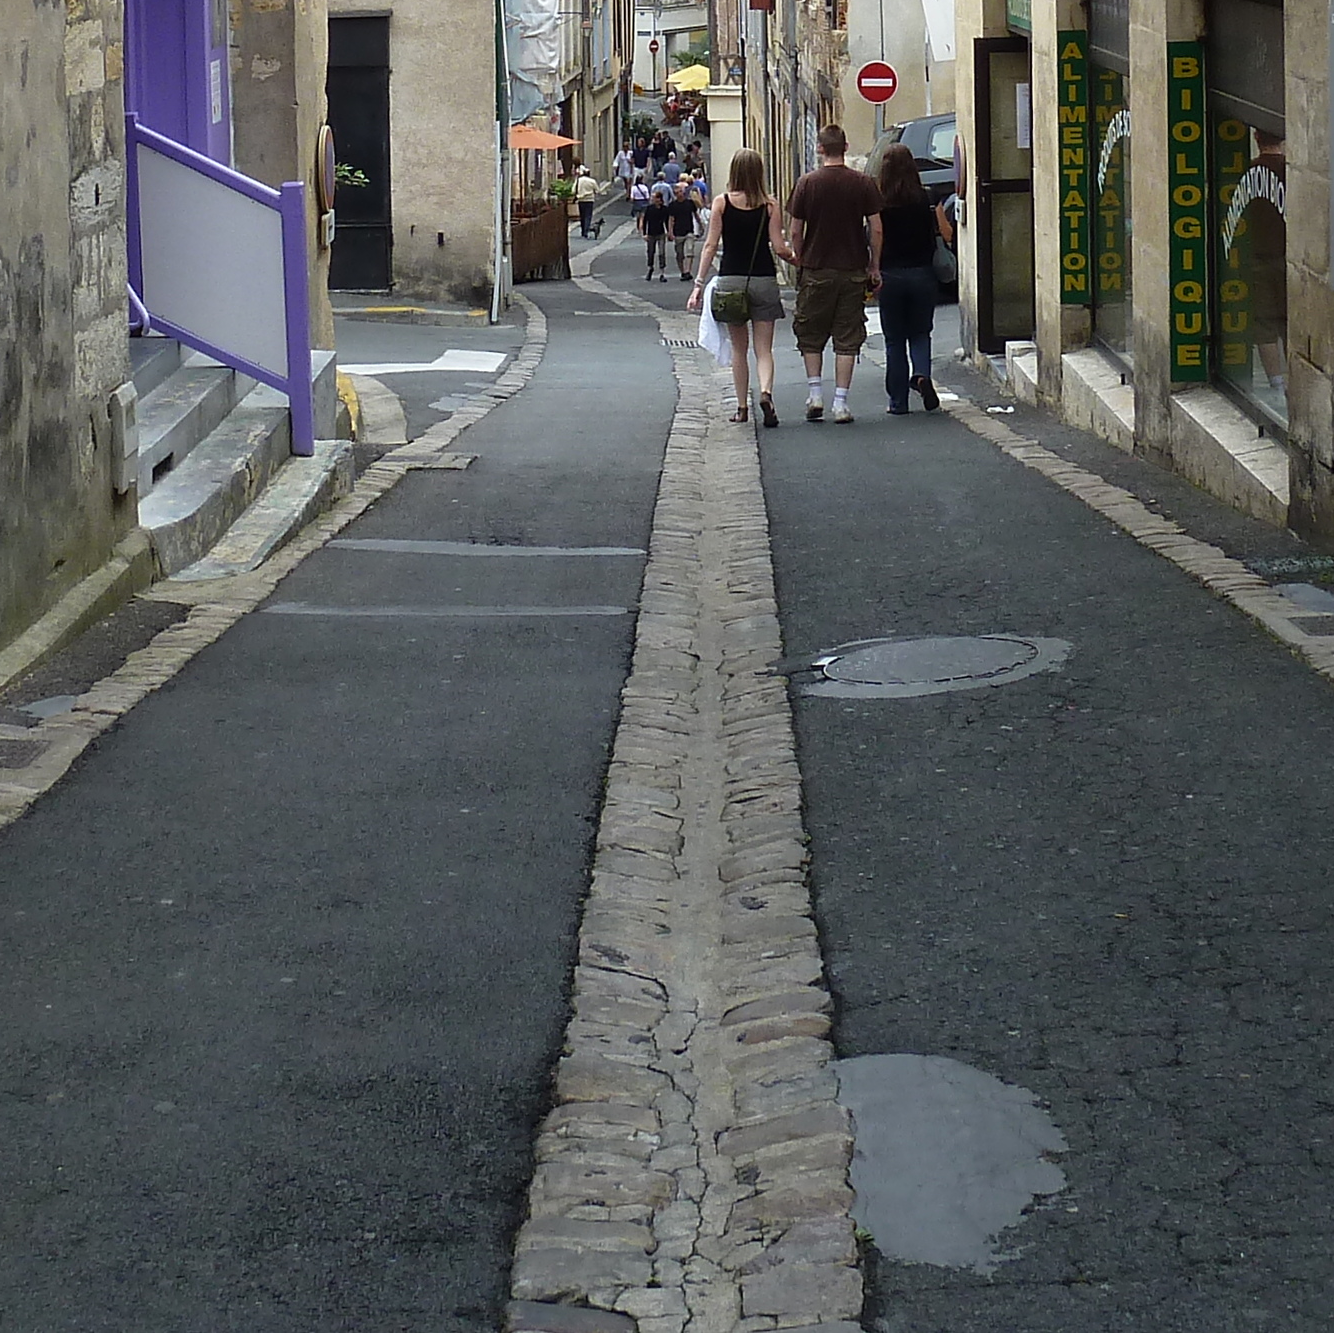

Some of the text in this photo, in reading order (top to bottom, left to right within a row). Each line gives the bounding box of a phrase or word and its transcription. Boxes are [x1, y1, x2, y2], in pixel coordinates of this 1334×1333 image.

[1060, 42, 1086, 291] ALIMENTATION
[1172, 57, 1203, 366] BIOLOGIQUE
[1222, 165, 1269, 260] ALIMENTATION
